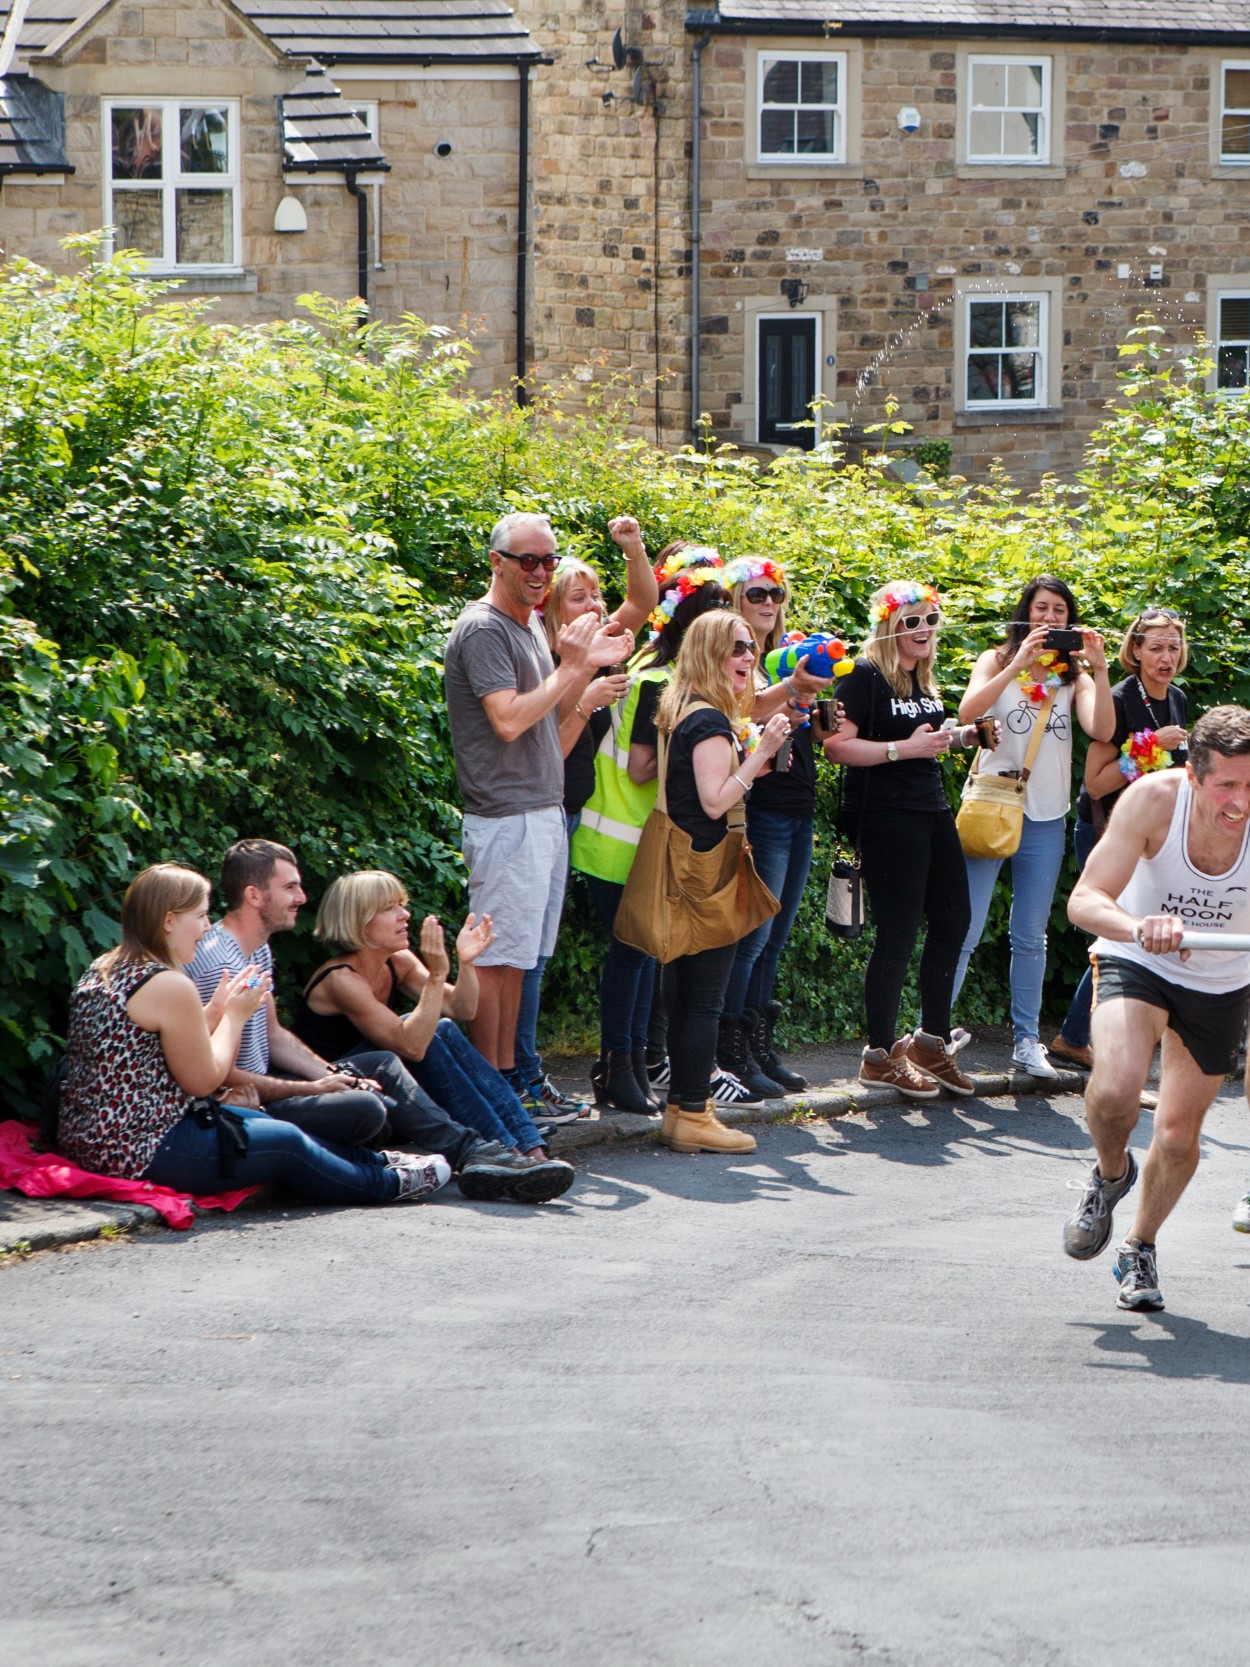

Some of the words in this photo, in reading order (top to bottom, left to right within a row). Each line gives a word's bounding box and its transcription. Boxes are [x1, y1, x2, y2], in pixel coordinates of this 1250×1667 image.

[890, 698, 922, 719] High
[1190, 887, 1215, 897] THE
[1167, 893, 1233, 909] HALF
[1160, 903, 1233, 921] MOON
